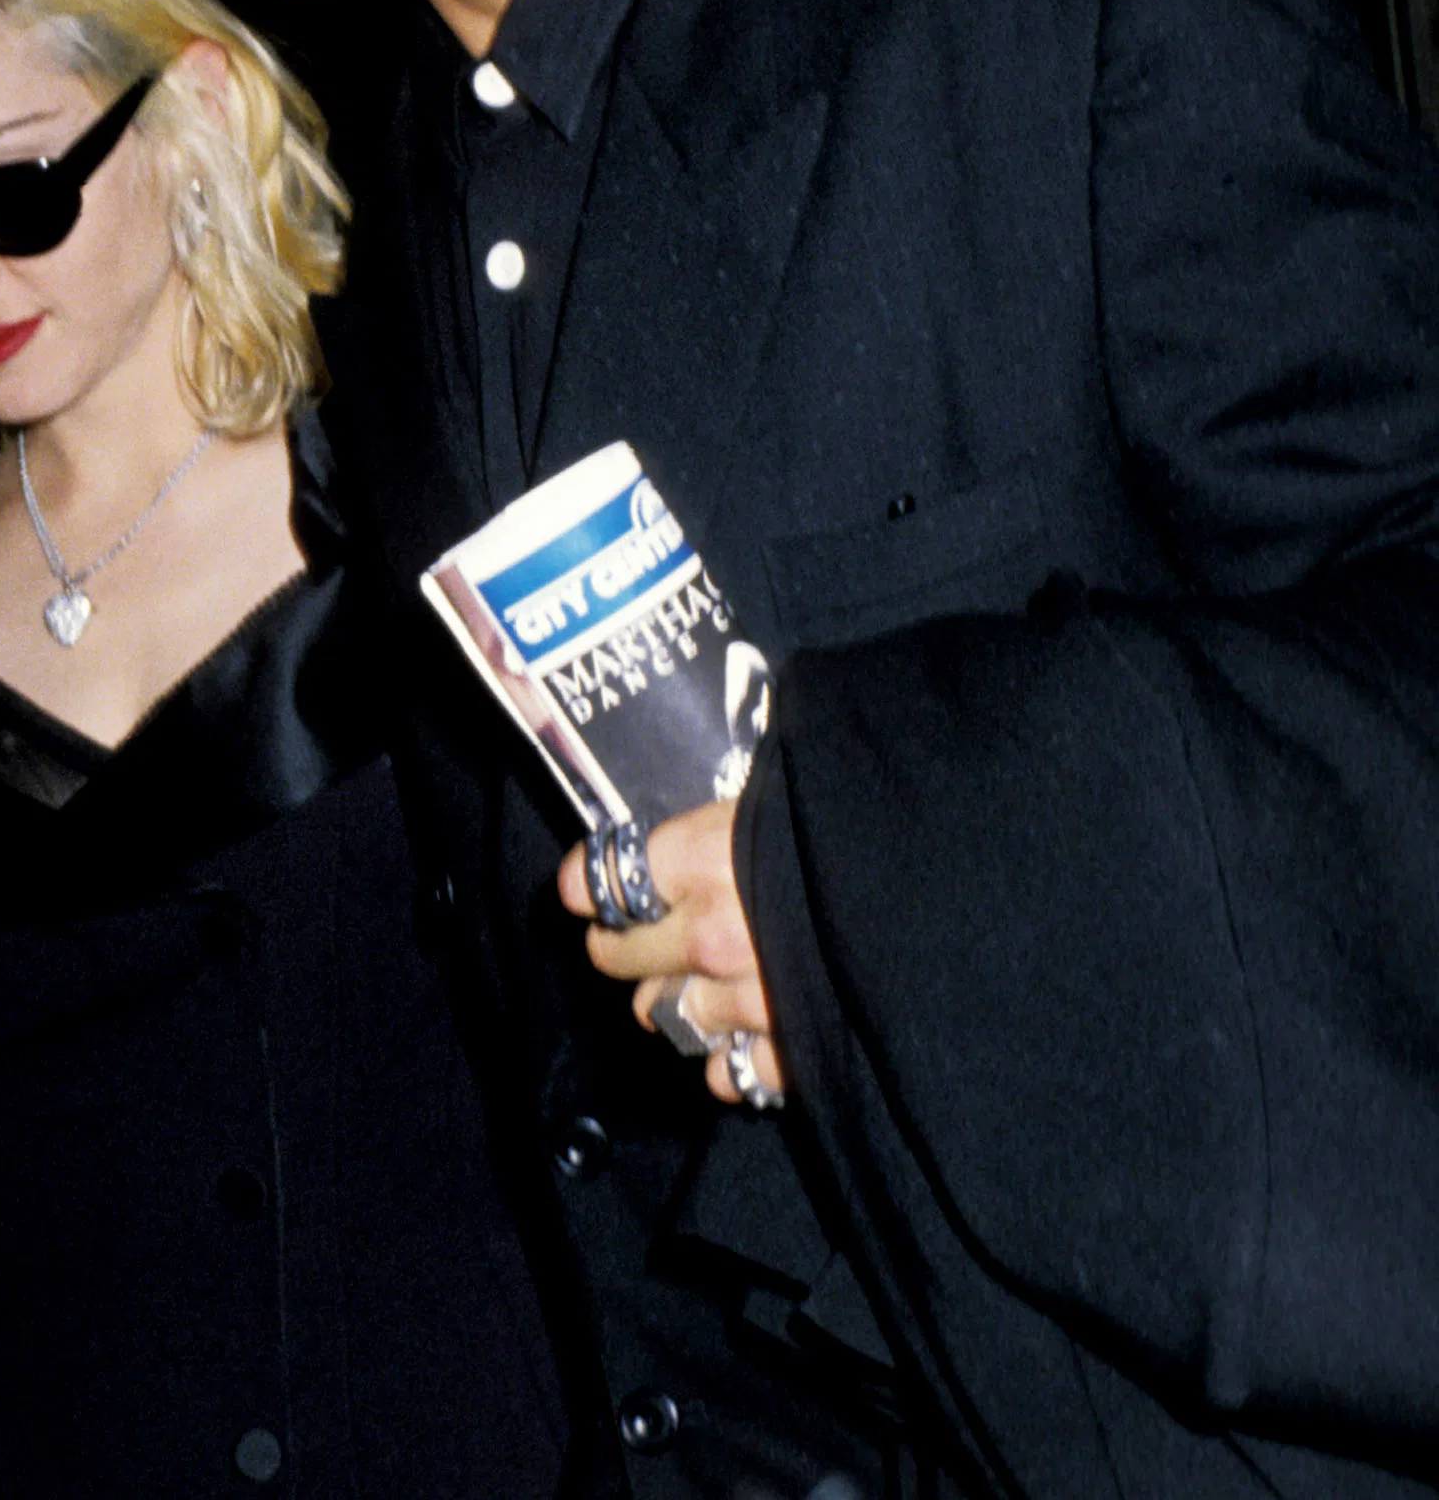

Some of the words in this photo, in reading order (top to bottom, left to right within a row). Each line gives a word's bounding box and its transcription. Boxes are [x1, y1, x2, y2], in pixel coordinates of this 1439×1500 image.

[510, 567, 589, 645] CITY
[551, 583, 712, 706] MARTHA
[569, 631, 698, 725] DANCE
